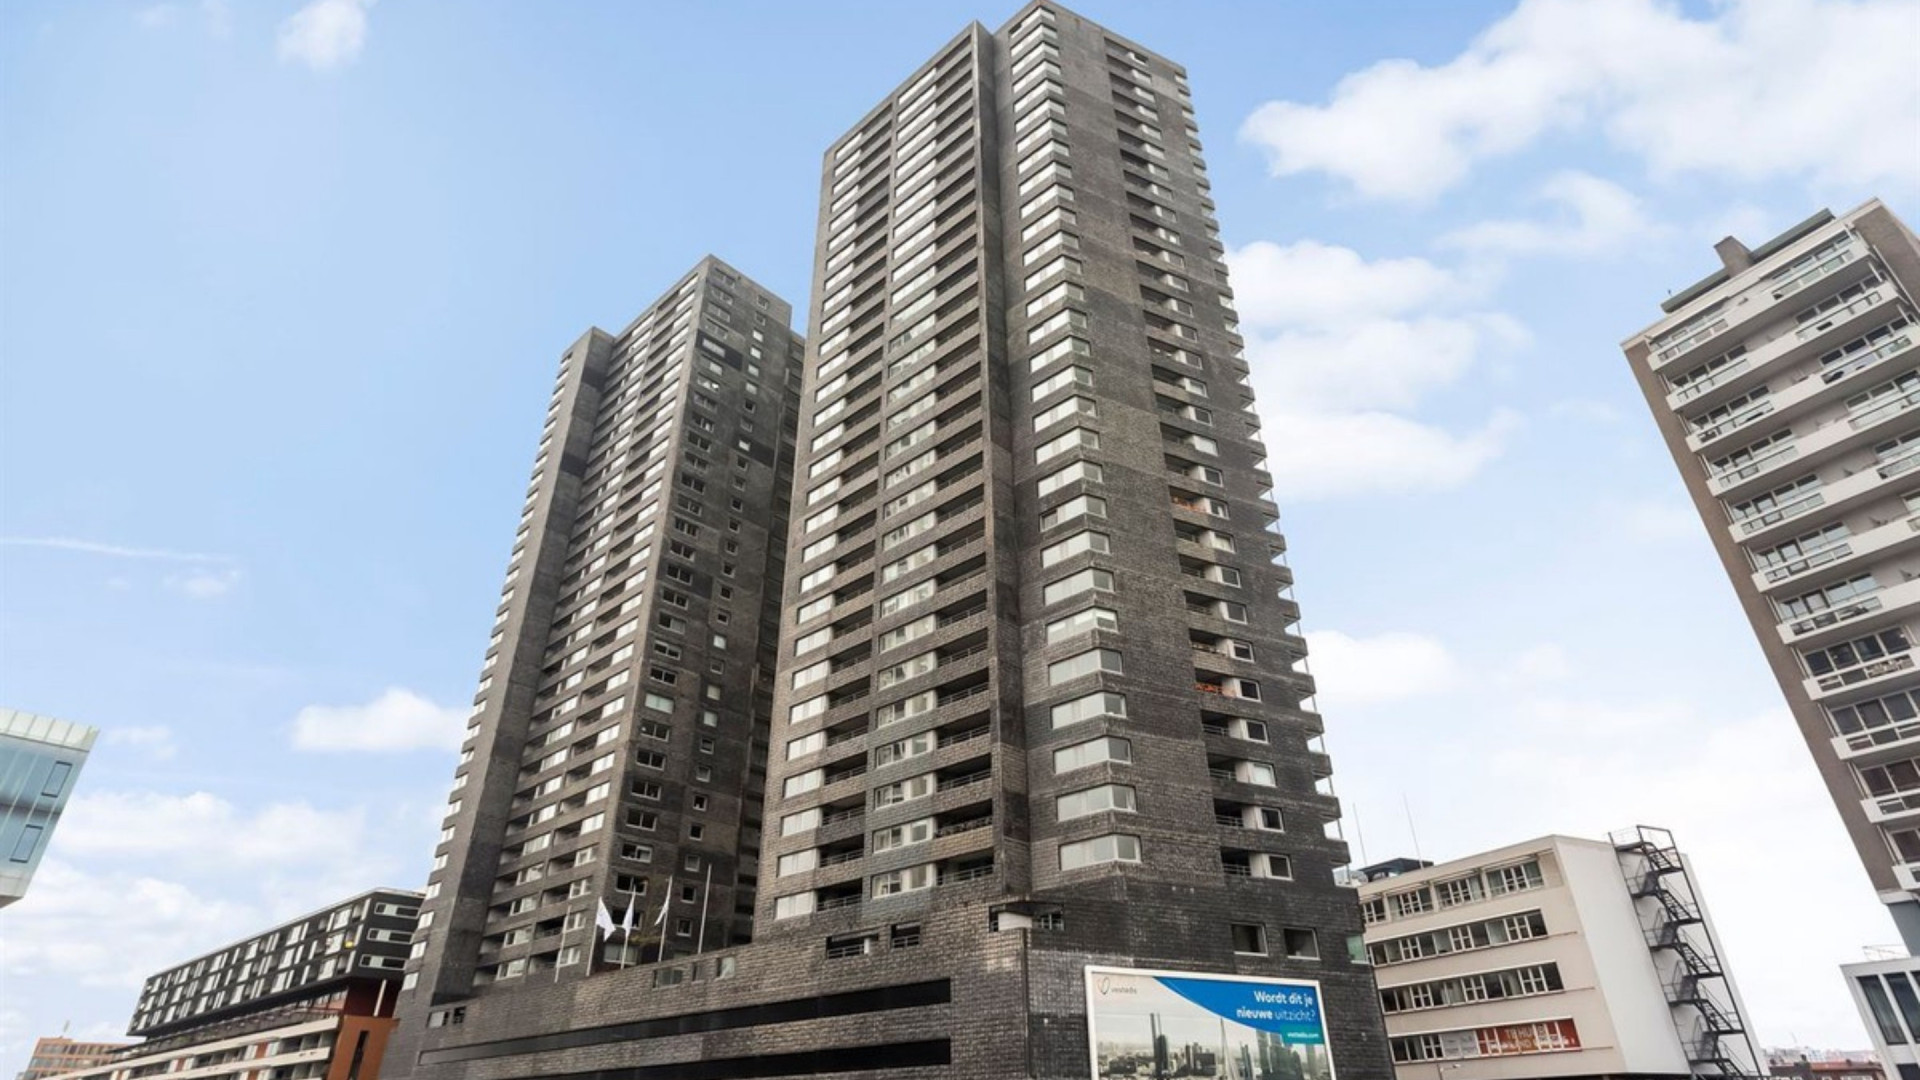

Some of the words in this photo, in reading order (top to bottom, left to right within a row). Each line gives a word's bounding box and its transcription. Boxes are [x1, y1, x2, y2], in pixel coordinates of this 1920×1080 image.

[1253, 990, 1287, 1005] Wordt
[1288, 991, 1303, 1005] dit
[1303, 993, 1313, 1008] je
[1236, 1006, 1273, 1020] nieuwe
[1274, 1009, 1316, 1022] uitzicht?
